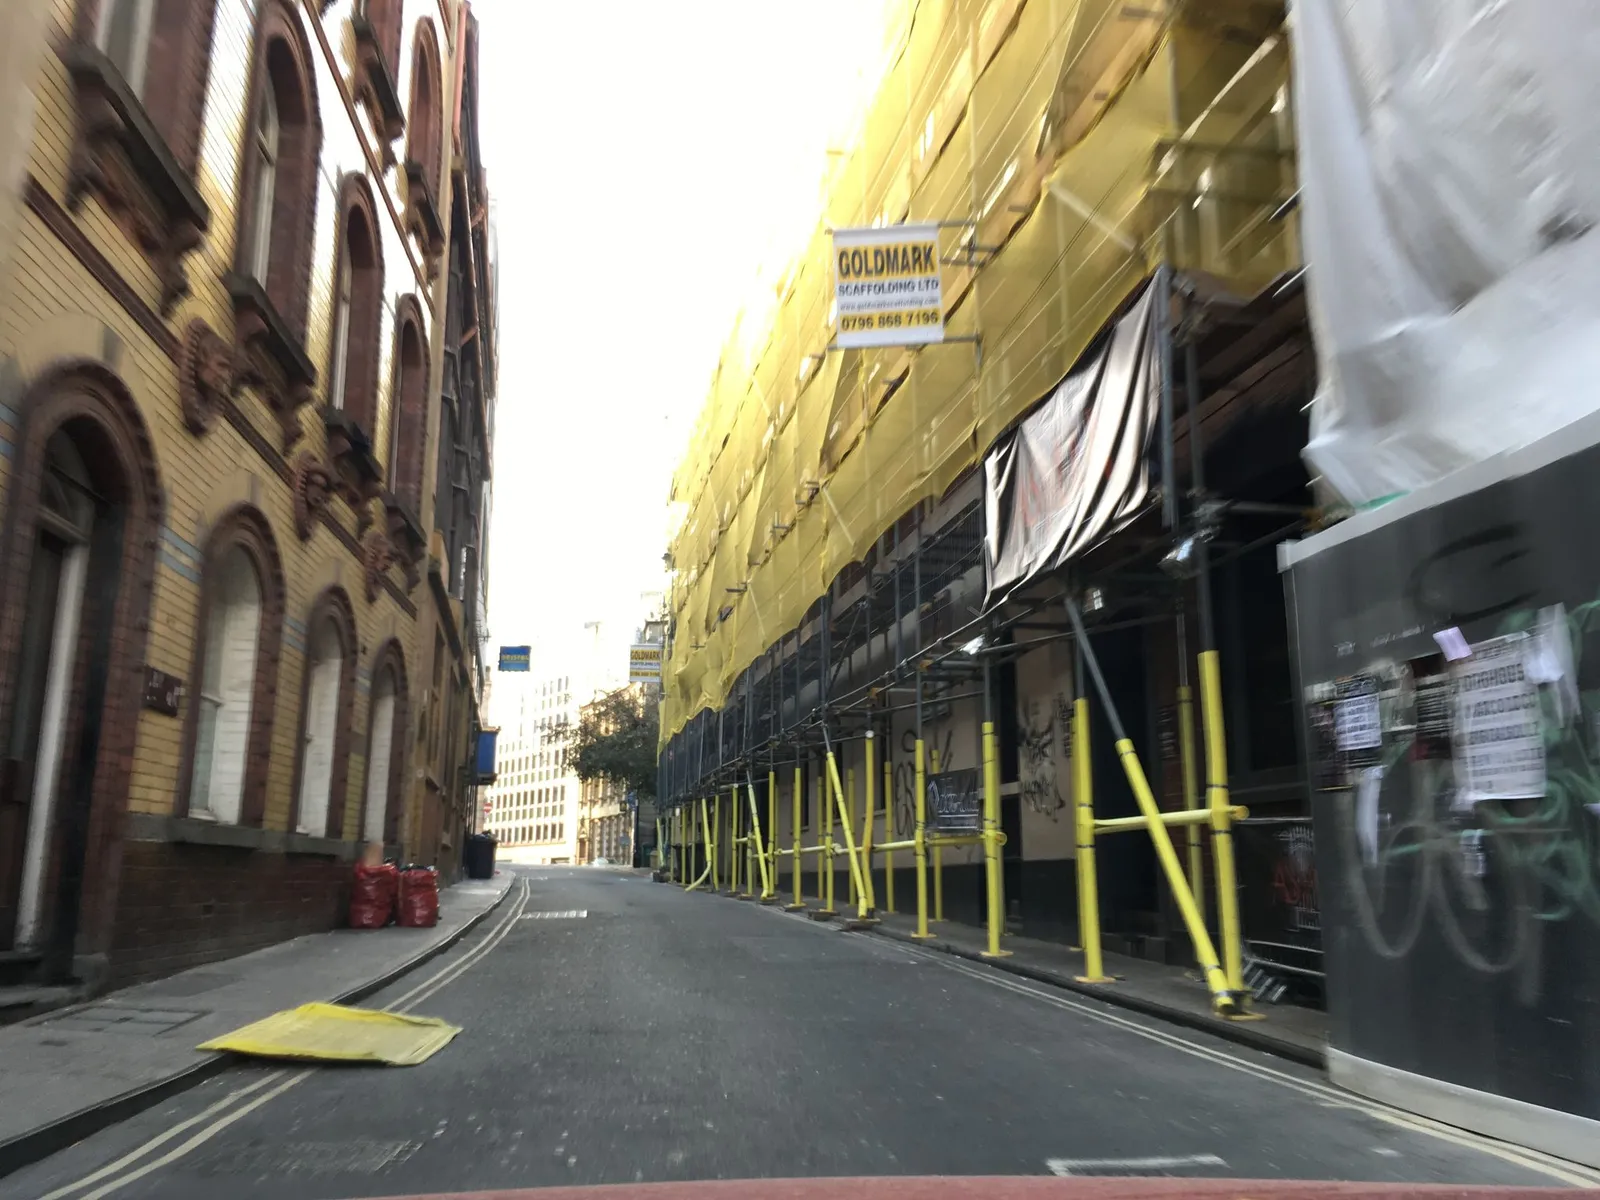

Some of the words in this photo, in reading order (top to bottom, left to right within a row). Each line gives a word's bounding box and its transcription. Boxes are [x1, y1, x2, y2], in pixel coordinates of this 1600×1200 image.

[839, 245, 935, 278] GOLDMARK
[838, 281, 915, 297] SCAFFOLDING
[918, 279, 939, 292] LTD
